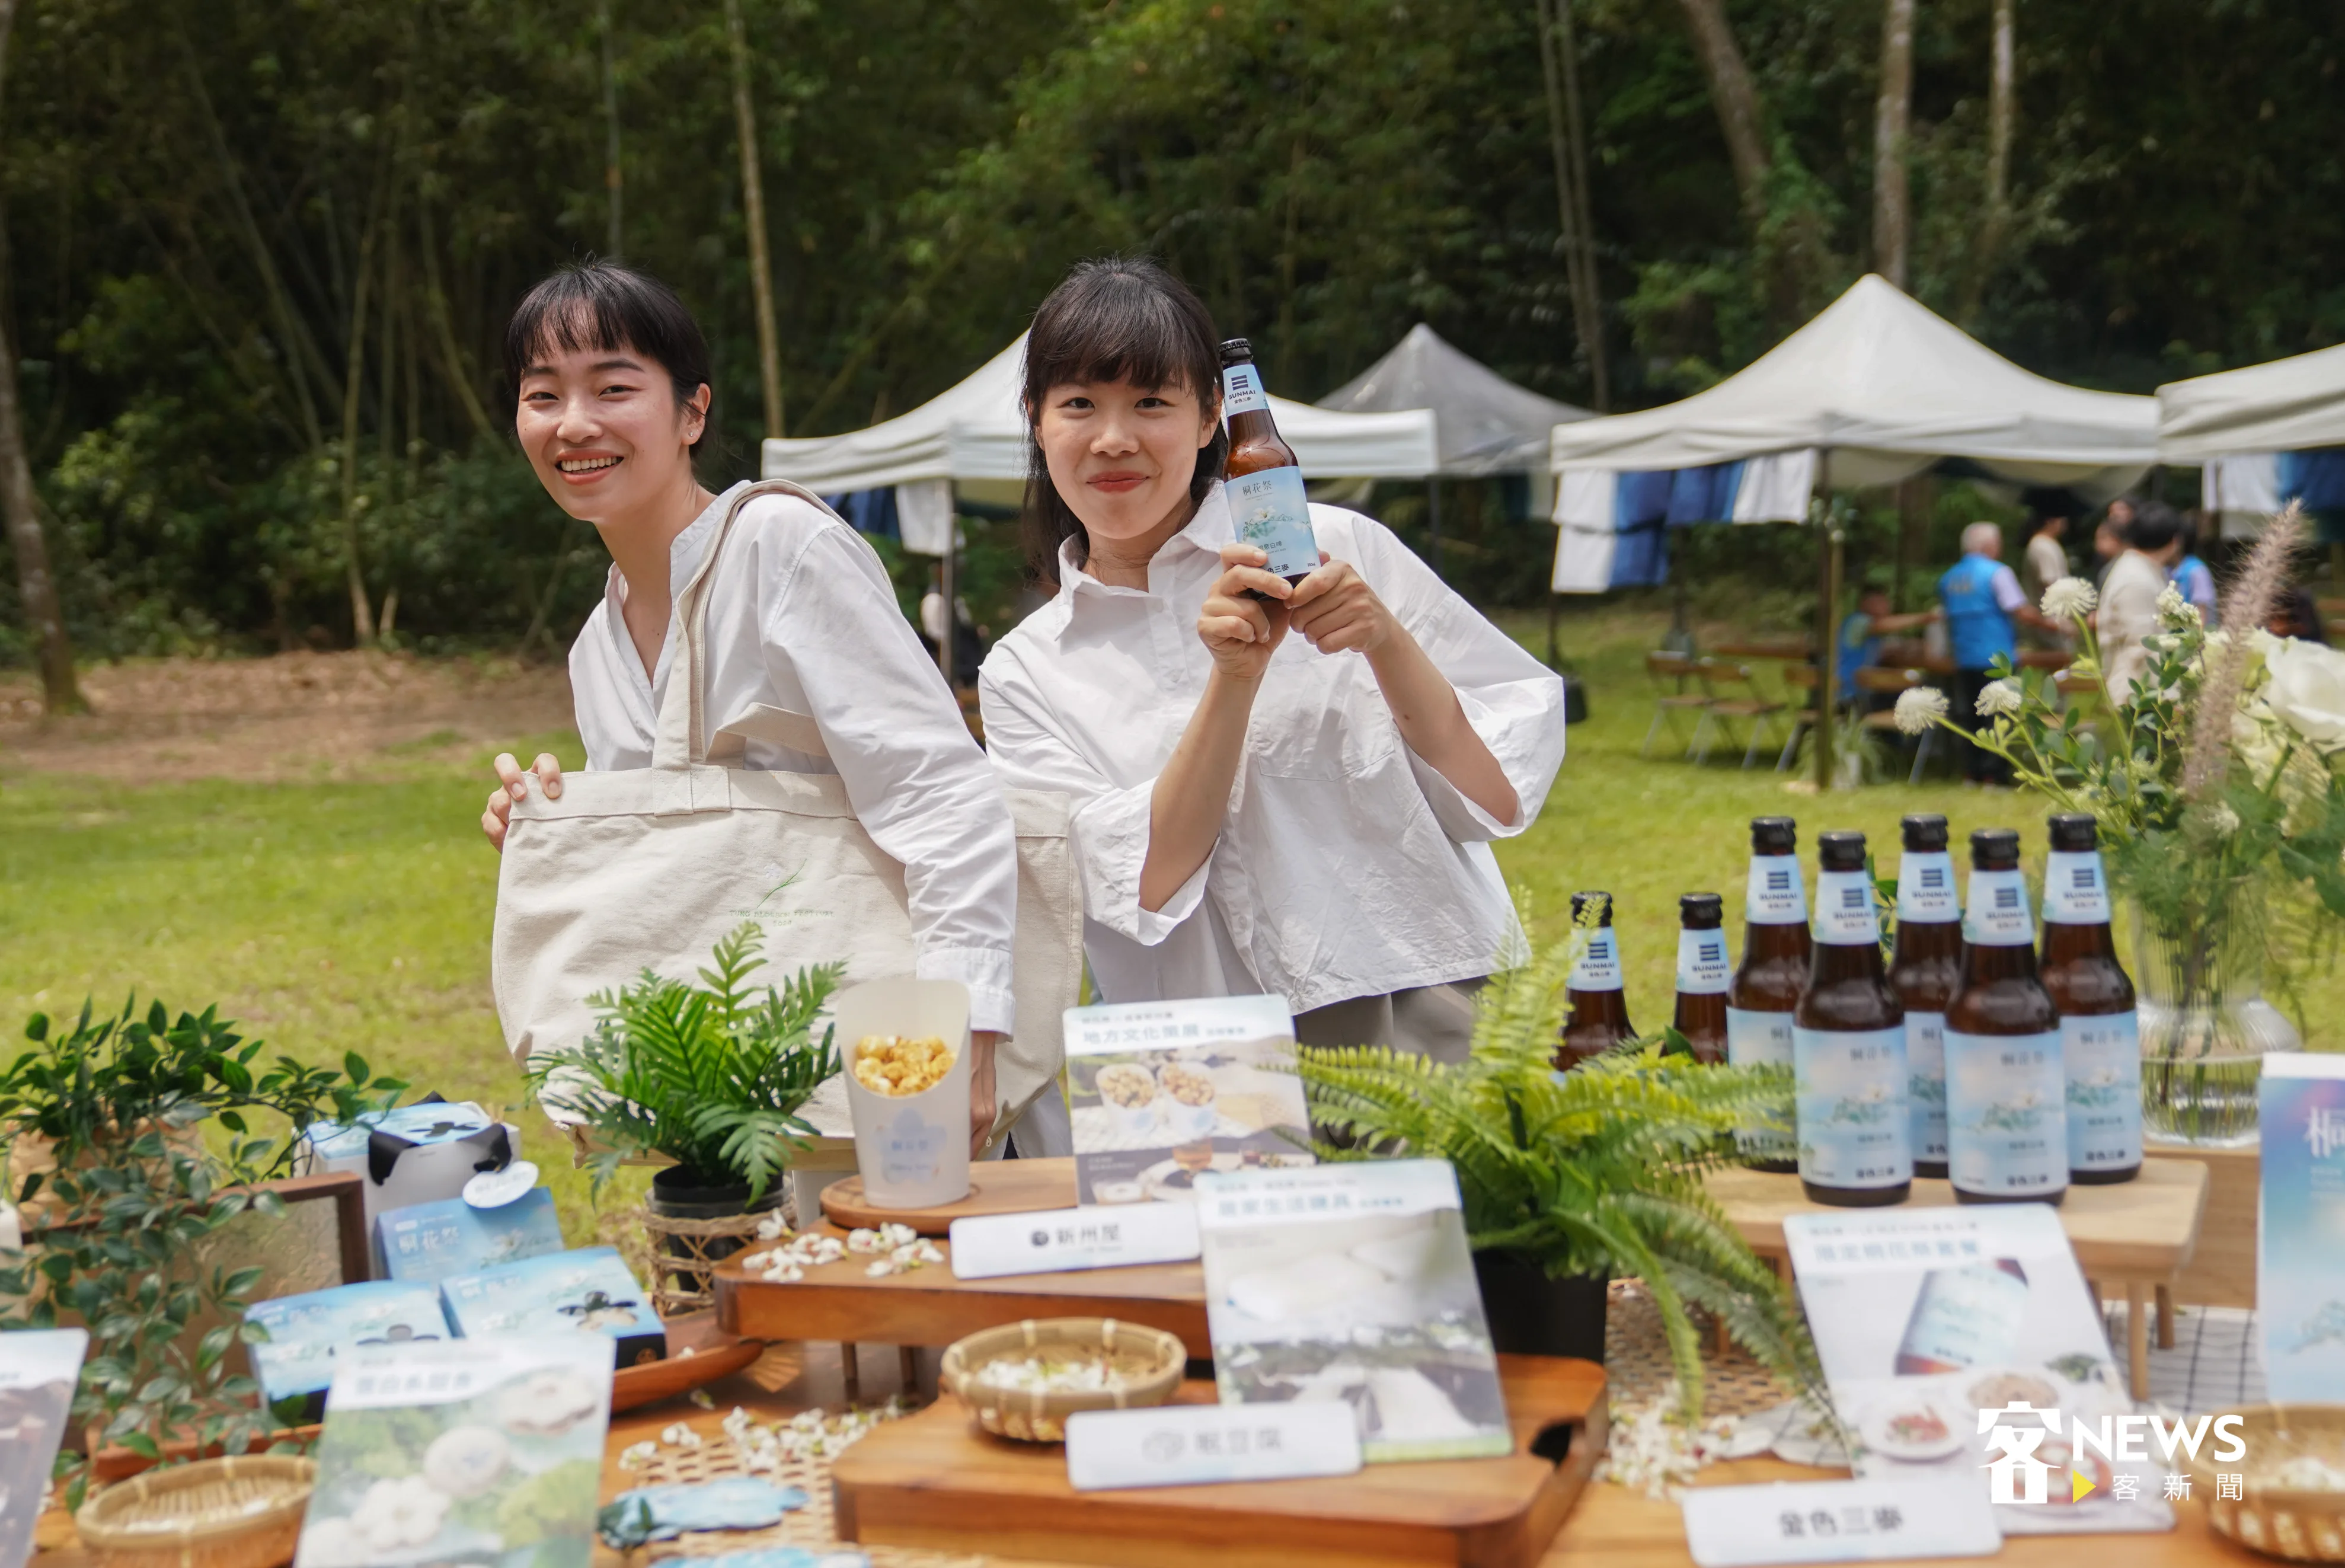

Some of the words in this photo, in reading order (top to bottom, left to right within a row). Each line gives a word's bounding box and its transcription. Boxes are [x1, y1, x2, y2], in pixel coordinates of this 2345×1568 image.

[1228, 389, 1256, 400] SUNMAI
[1242, 480, 1271, 496] 桐花祭
[1055, 1224, 1120, 1246] 新州屋
